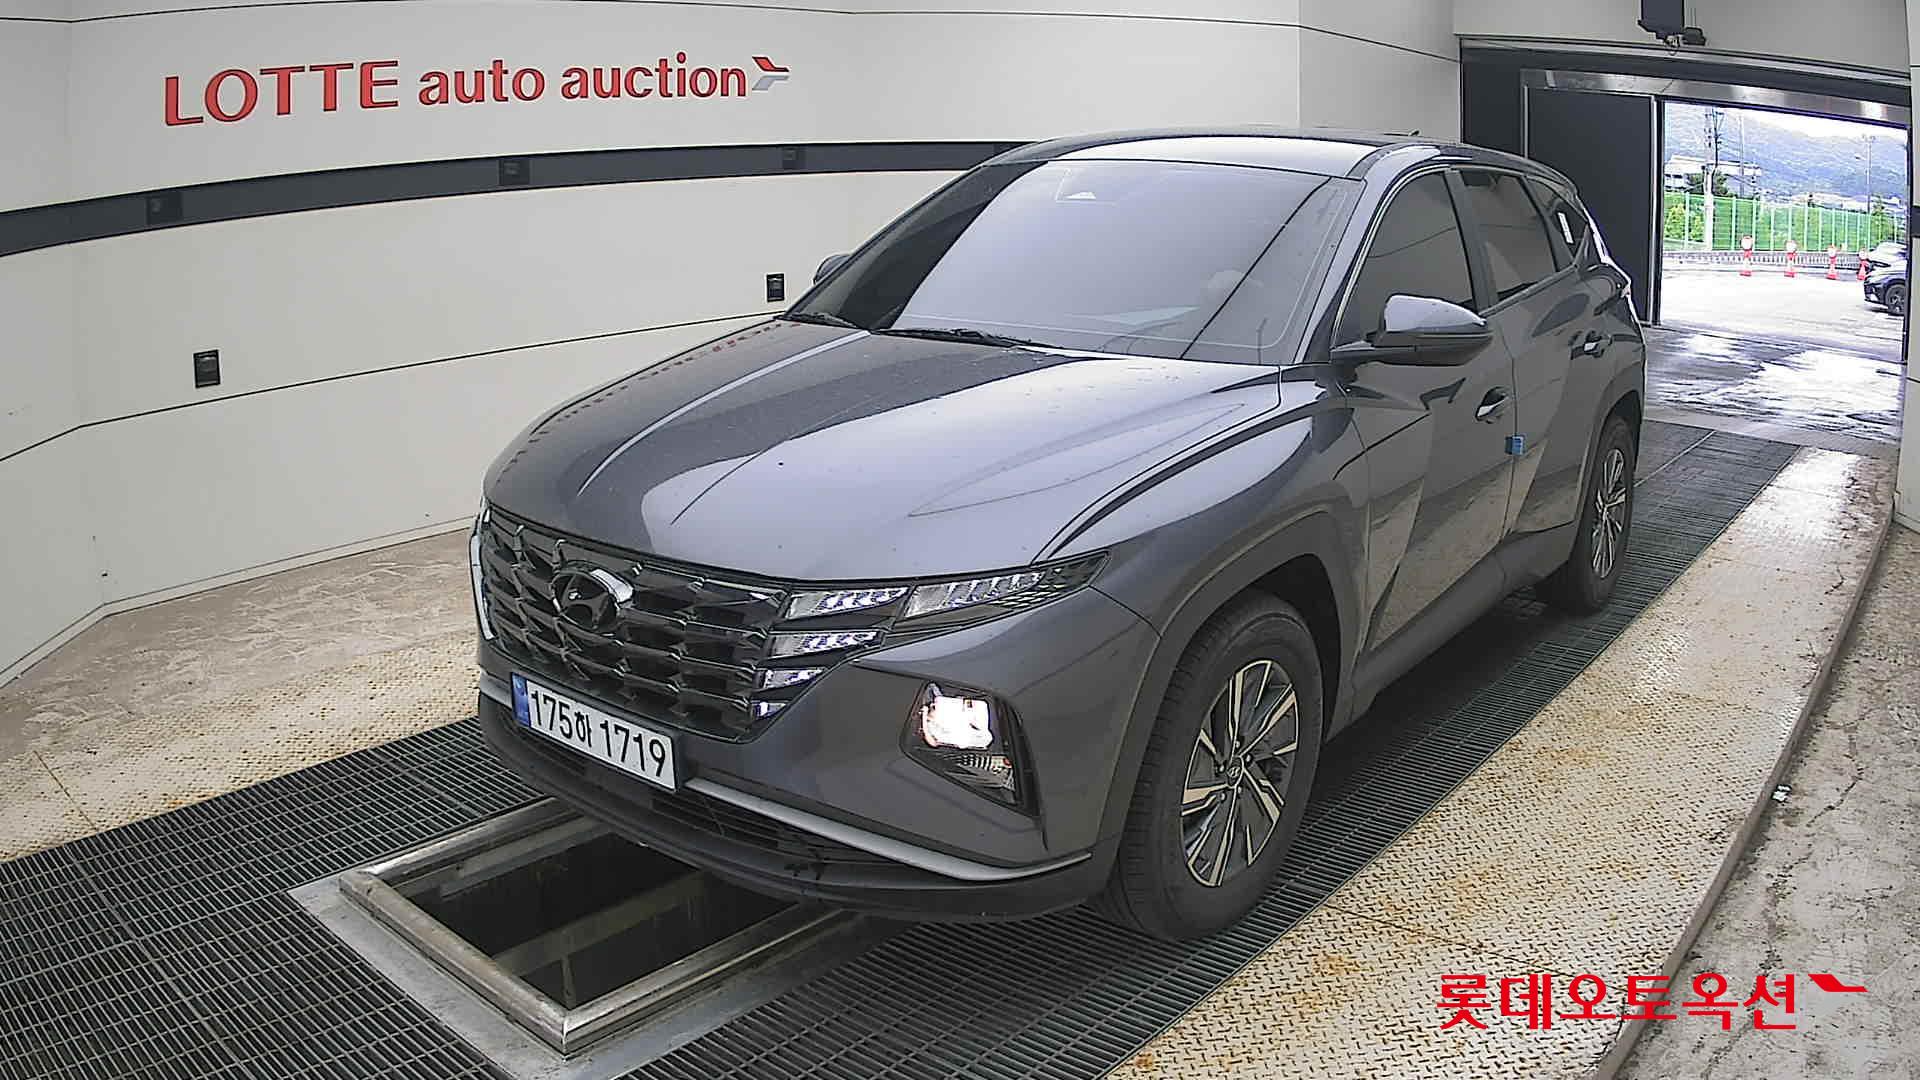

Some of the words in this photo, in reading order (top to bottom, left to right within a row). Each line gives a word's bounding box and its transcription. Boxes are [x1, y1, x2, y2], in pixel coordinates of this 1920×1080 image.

[165, 60, 399, 126] LOTTE
[418, 59, 545, 105] auto
[560, 51, 747, 101] auction
[531, 690, 592, 748] 175하
[600, 719, 666, 777] 1719
